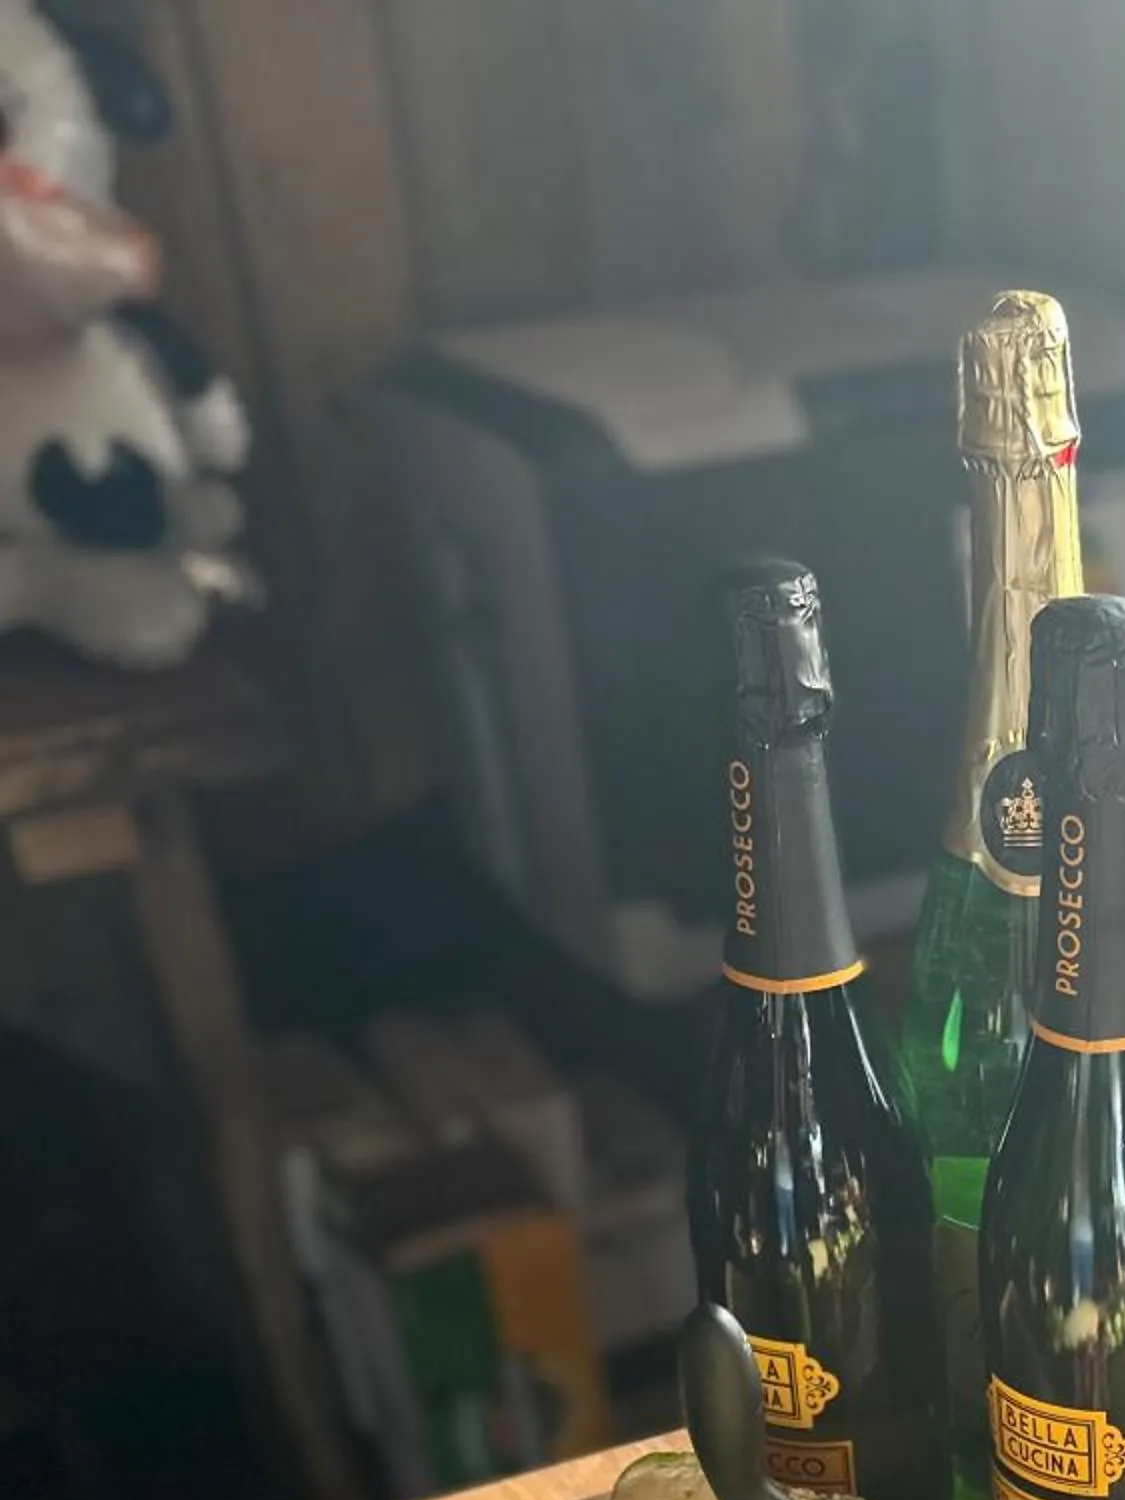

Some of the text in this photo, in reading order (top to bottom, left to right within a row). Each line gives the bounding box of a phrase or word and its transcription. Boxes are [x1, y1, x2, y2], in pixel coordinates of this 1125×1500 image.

[729, 760, 756, 937] PROSECCO
[1056, 815, 1085, 997] PROSECCO
[1006, 1406, 1078, 1449] BELLA
[1008, 1437, 1079, 1477] CUCINA
